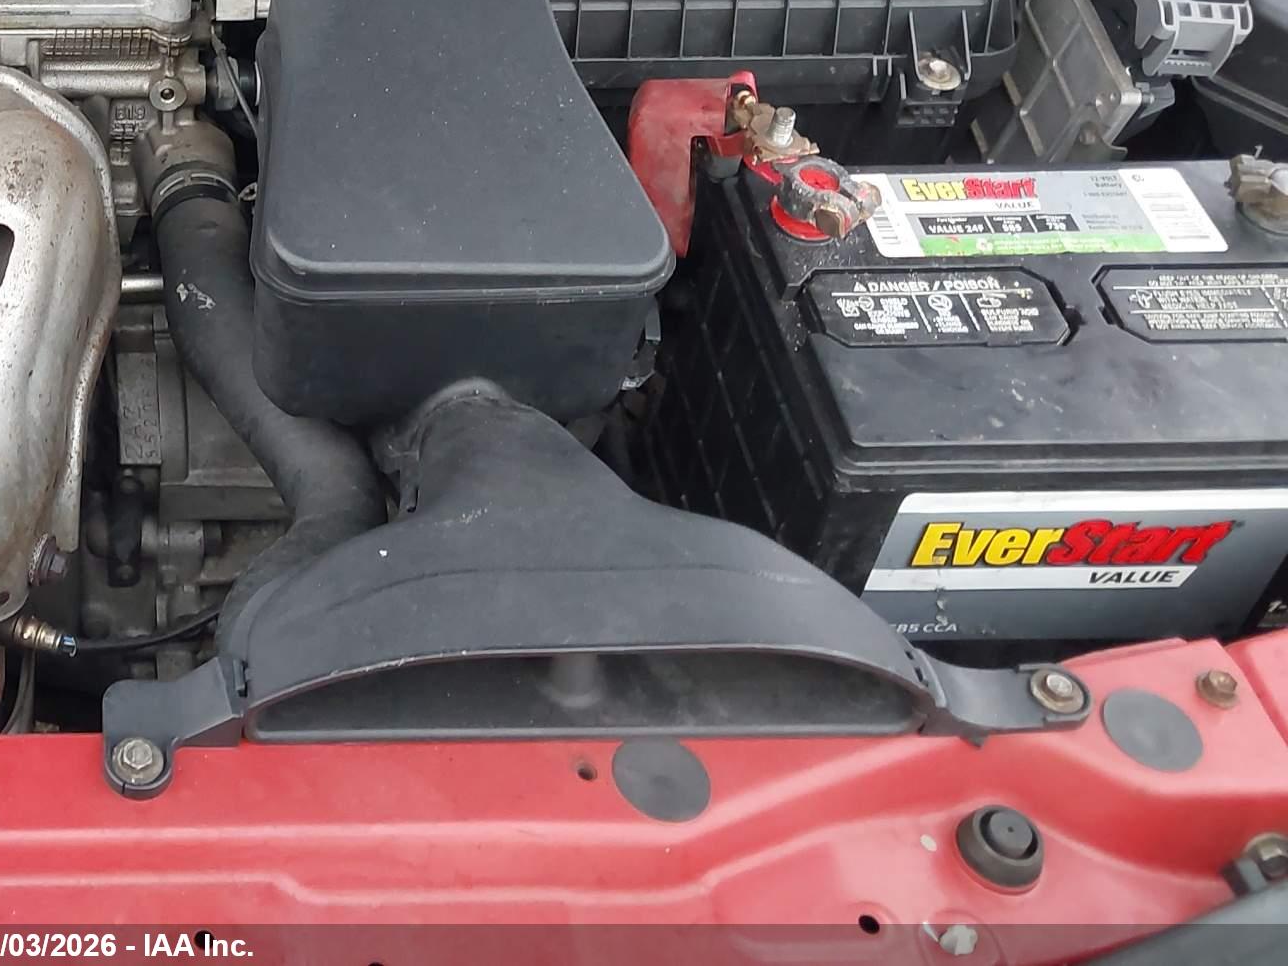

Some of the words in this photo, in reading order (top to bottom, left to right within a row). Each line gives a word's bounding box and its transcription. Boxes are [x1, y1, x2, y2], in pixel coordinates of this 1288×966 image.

[901, 177, 1038, 202] EverStart
[928, 224, 963, 234] VALUE
[868, 282, 930, 292] DANGER
[943, 280, 1000, 290] POISON
[910, 518, 1236, 567] EverStart
[1089, 570, 1180, 584] VALUE
[923, 623, 957, 634] CCA
